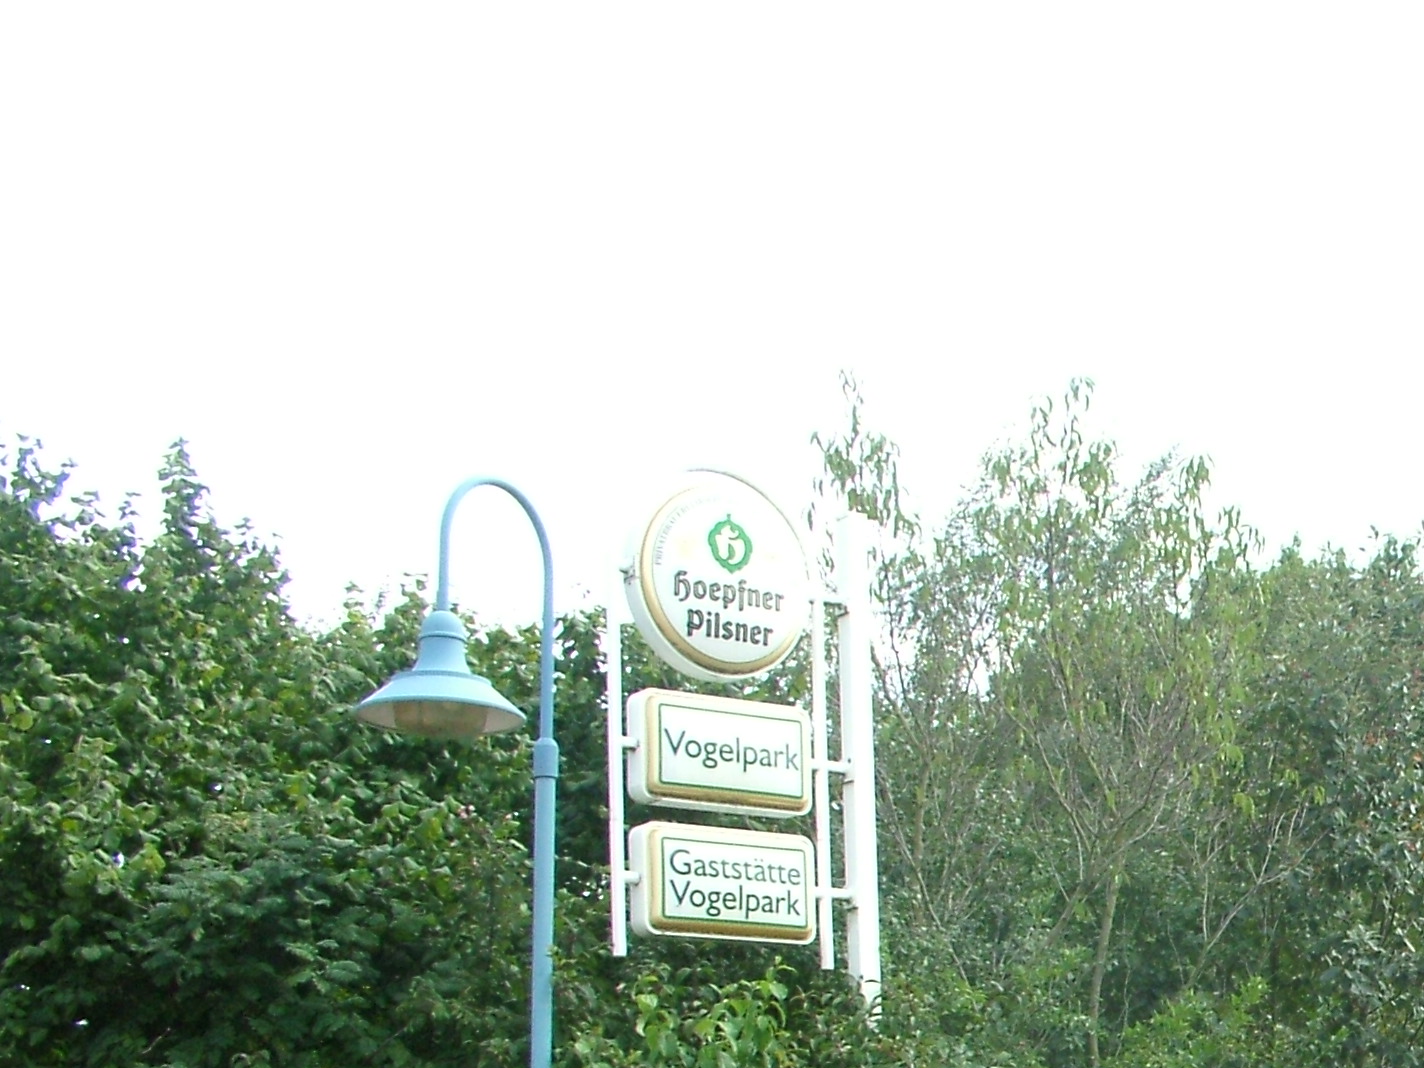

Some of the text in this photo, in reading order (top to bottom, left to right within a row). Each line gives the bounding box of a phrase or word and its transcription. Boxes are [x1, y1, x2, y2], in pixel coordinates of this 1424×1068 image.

[674, 570, 785, 612] Hoepfner
[686, 608, 774, 647] Pilsner
[664, 727, 800, 773] Vogelpark
[669, 849, 801, 886] Gaststätte
[669, 879, 801, 920] Vogelpark
